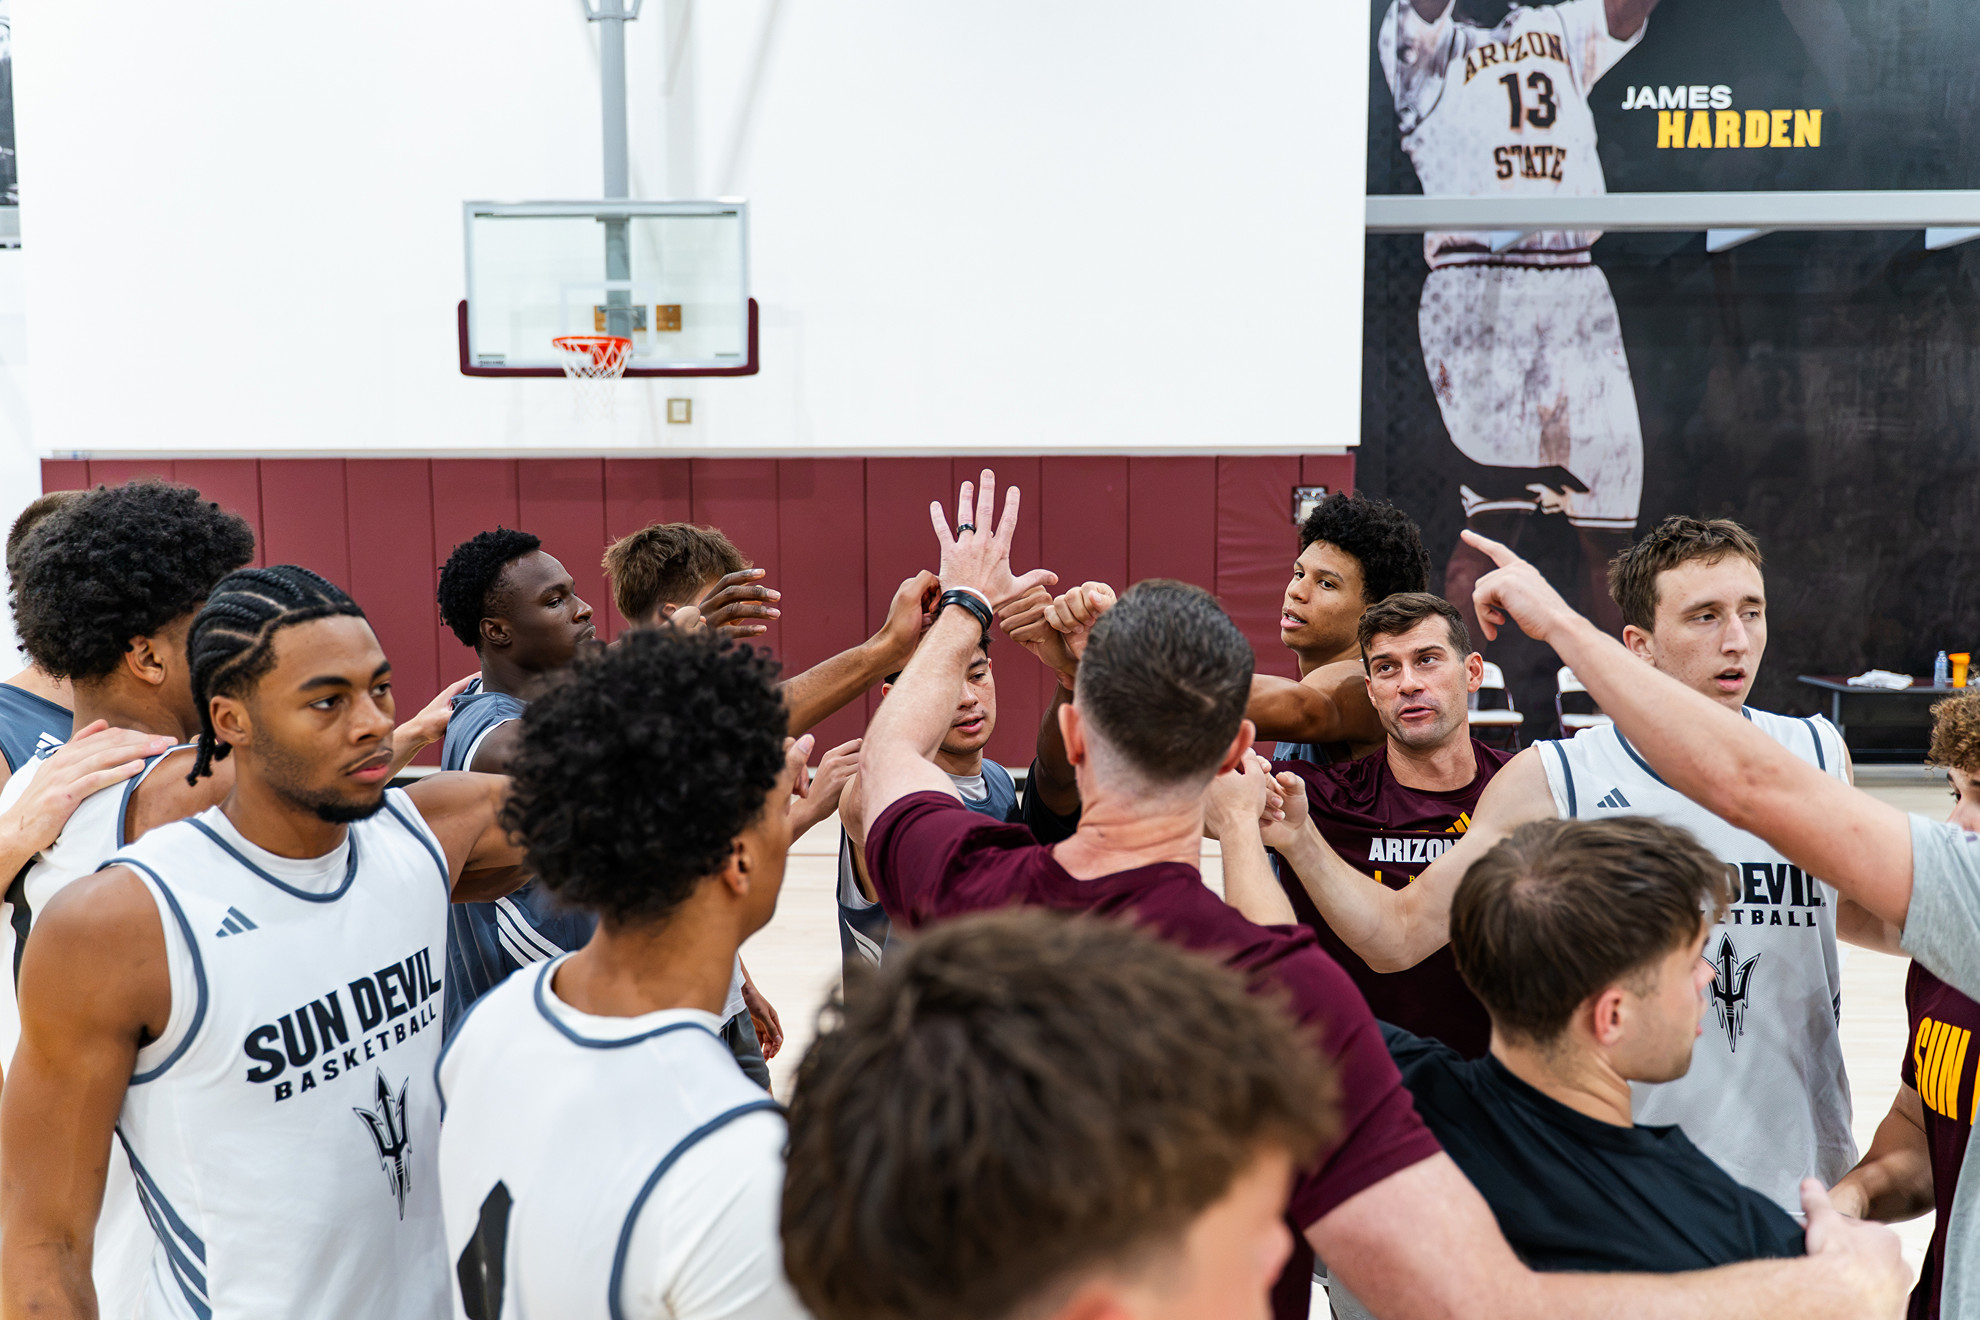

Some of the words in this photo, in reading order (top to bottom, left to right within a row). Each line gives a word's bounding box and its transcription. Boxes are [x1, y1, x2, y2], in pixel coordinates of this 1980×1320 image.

[1499, 71, 1557, 130] 13
[1621, 85, 1733, 110] JAMES
[1657, 109, 1823, 149] HARDEN
[1494, 145, 1567, 183] STATE
[244, 989, 350, 1083] SUN
[347, 946, 442, 1034] DEVIL
[274, 1003, 437, 1102] BASKETBALL
[1914, 1017, 1972, 1121] SUN
